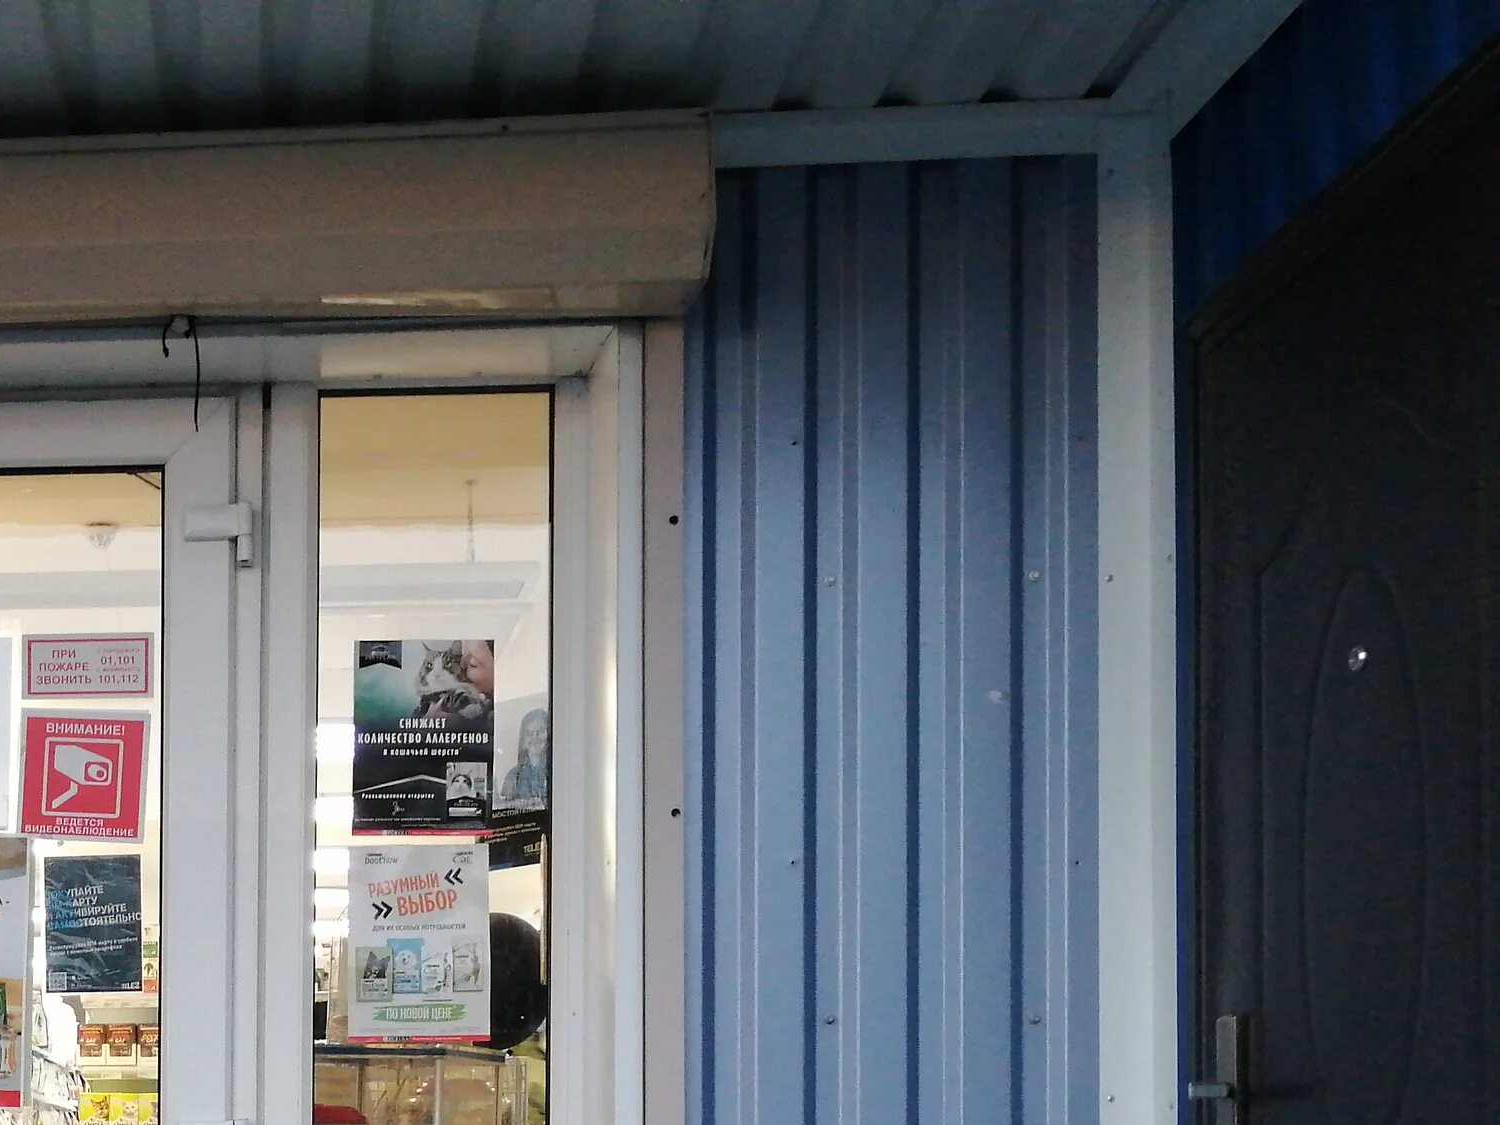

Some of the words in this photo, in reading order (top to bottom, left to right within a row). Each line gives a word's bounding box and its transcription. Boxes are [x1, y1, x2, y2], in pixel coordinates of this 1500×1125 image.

[52, 649, 77, 660] ПРИ
[39, 661, 90, 673] ПОЖАРЕ
[36, 674, 93, 685] ЗВОНИТЬ
[46, 722, 126, 736] ВНИМАНИЕ!
[399, 717, 447, 729] СНИЖАЕТ
[358, 732, 422, 744] КОЛИЧЕСТВО
[425, 732, 489, 744] АЛЛЕРГЕНОВ
[390, 747, 428, 756] кошачьей
[55, 817, 104, 828] ВЕДЕТСЯ
[24, 824, 135, 838] ВИДЕОНАБЛЮДЕНИЕ
[524, 841, 541, 853] TELE
[368, 871, 439, 898] РАЗУМНЫЙ
[396, 889, 458, 917] ВЫБОР
[386, 1008, 398, 1020] ПО
[400, 1006, 429, 1020] НОВОЙ
[431, 1006, 453, 1021] ЦЕНЕ
